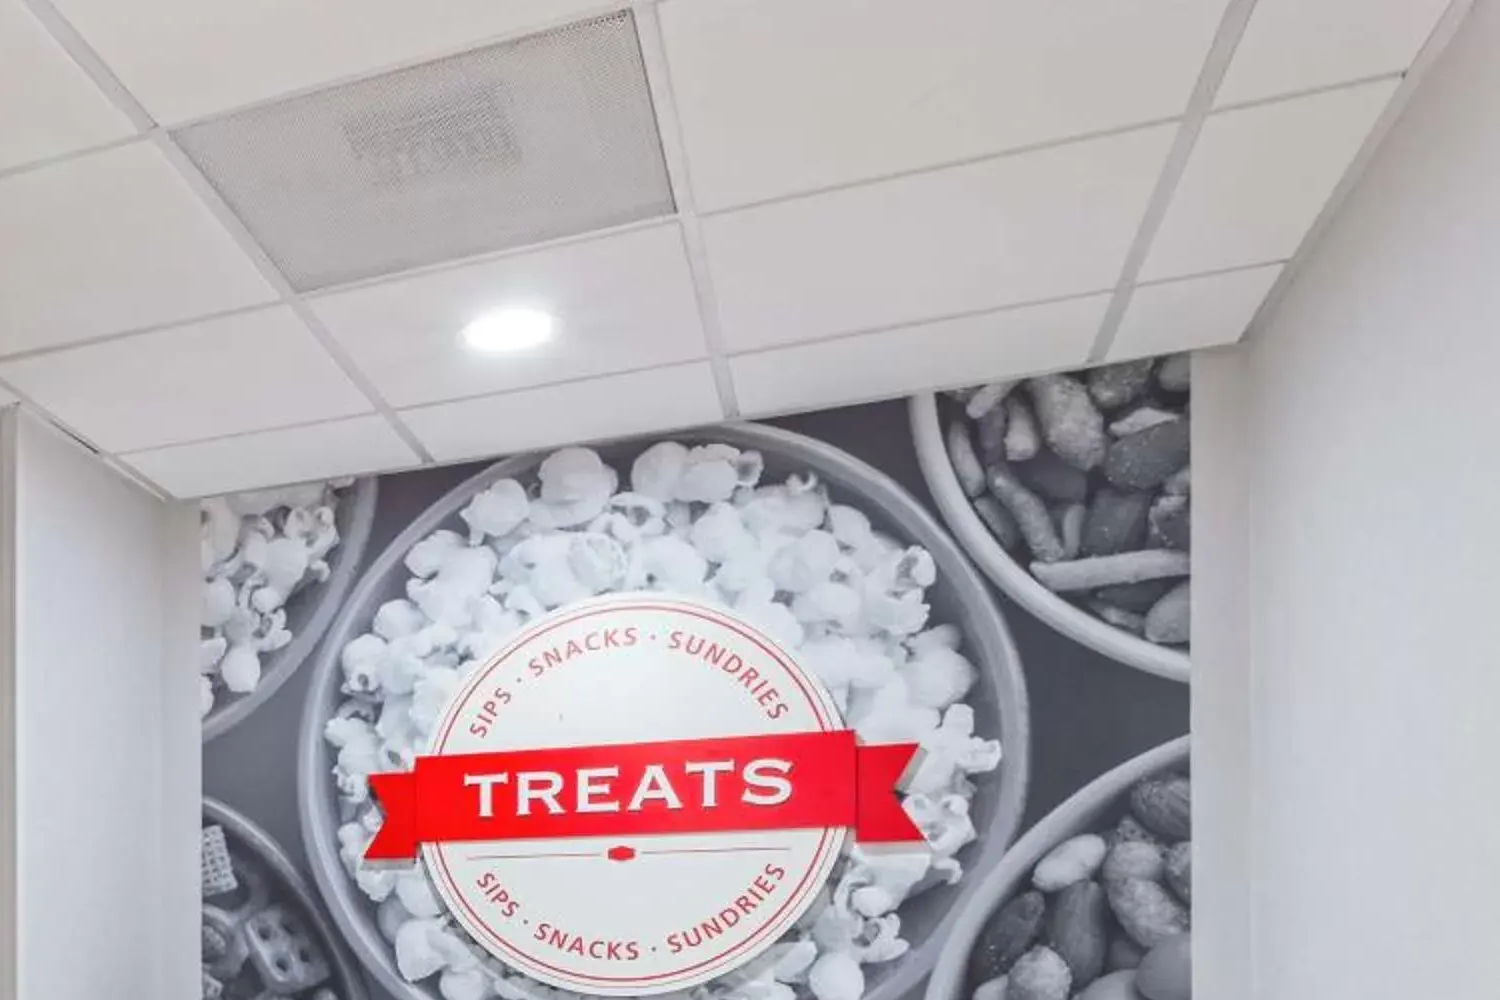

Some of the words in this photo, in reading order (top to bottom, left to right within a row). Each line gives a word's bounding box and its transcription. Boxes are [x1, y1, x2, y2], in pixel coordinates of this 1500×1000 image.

[469, 687, 513, 738] SIPS
[527, 626, 637, 676] SNACKS
[668, 630, 789, 721] SUNDRIES
[463, 757, 795, 818] TREATS
[476, 871, 520, 919] SIPS
[533, 922, 639, 961] SNACKS
[666, 863, 786, 955] SUNDRIES
